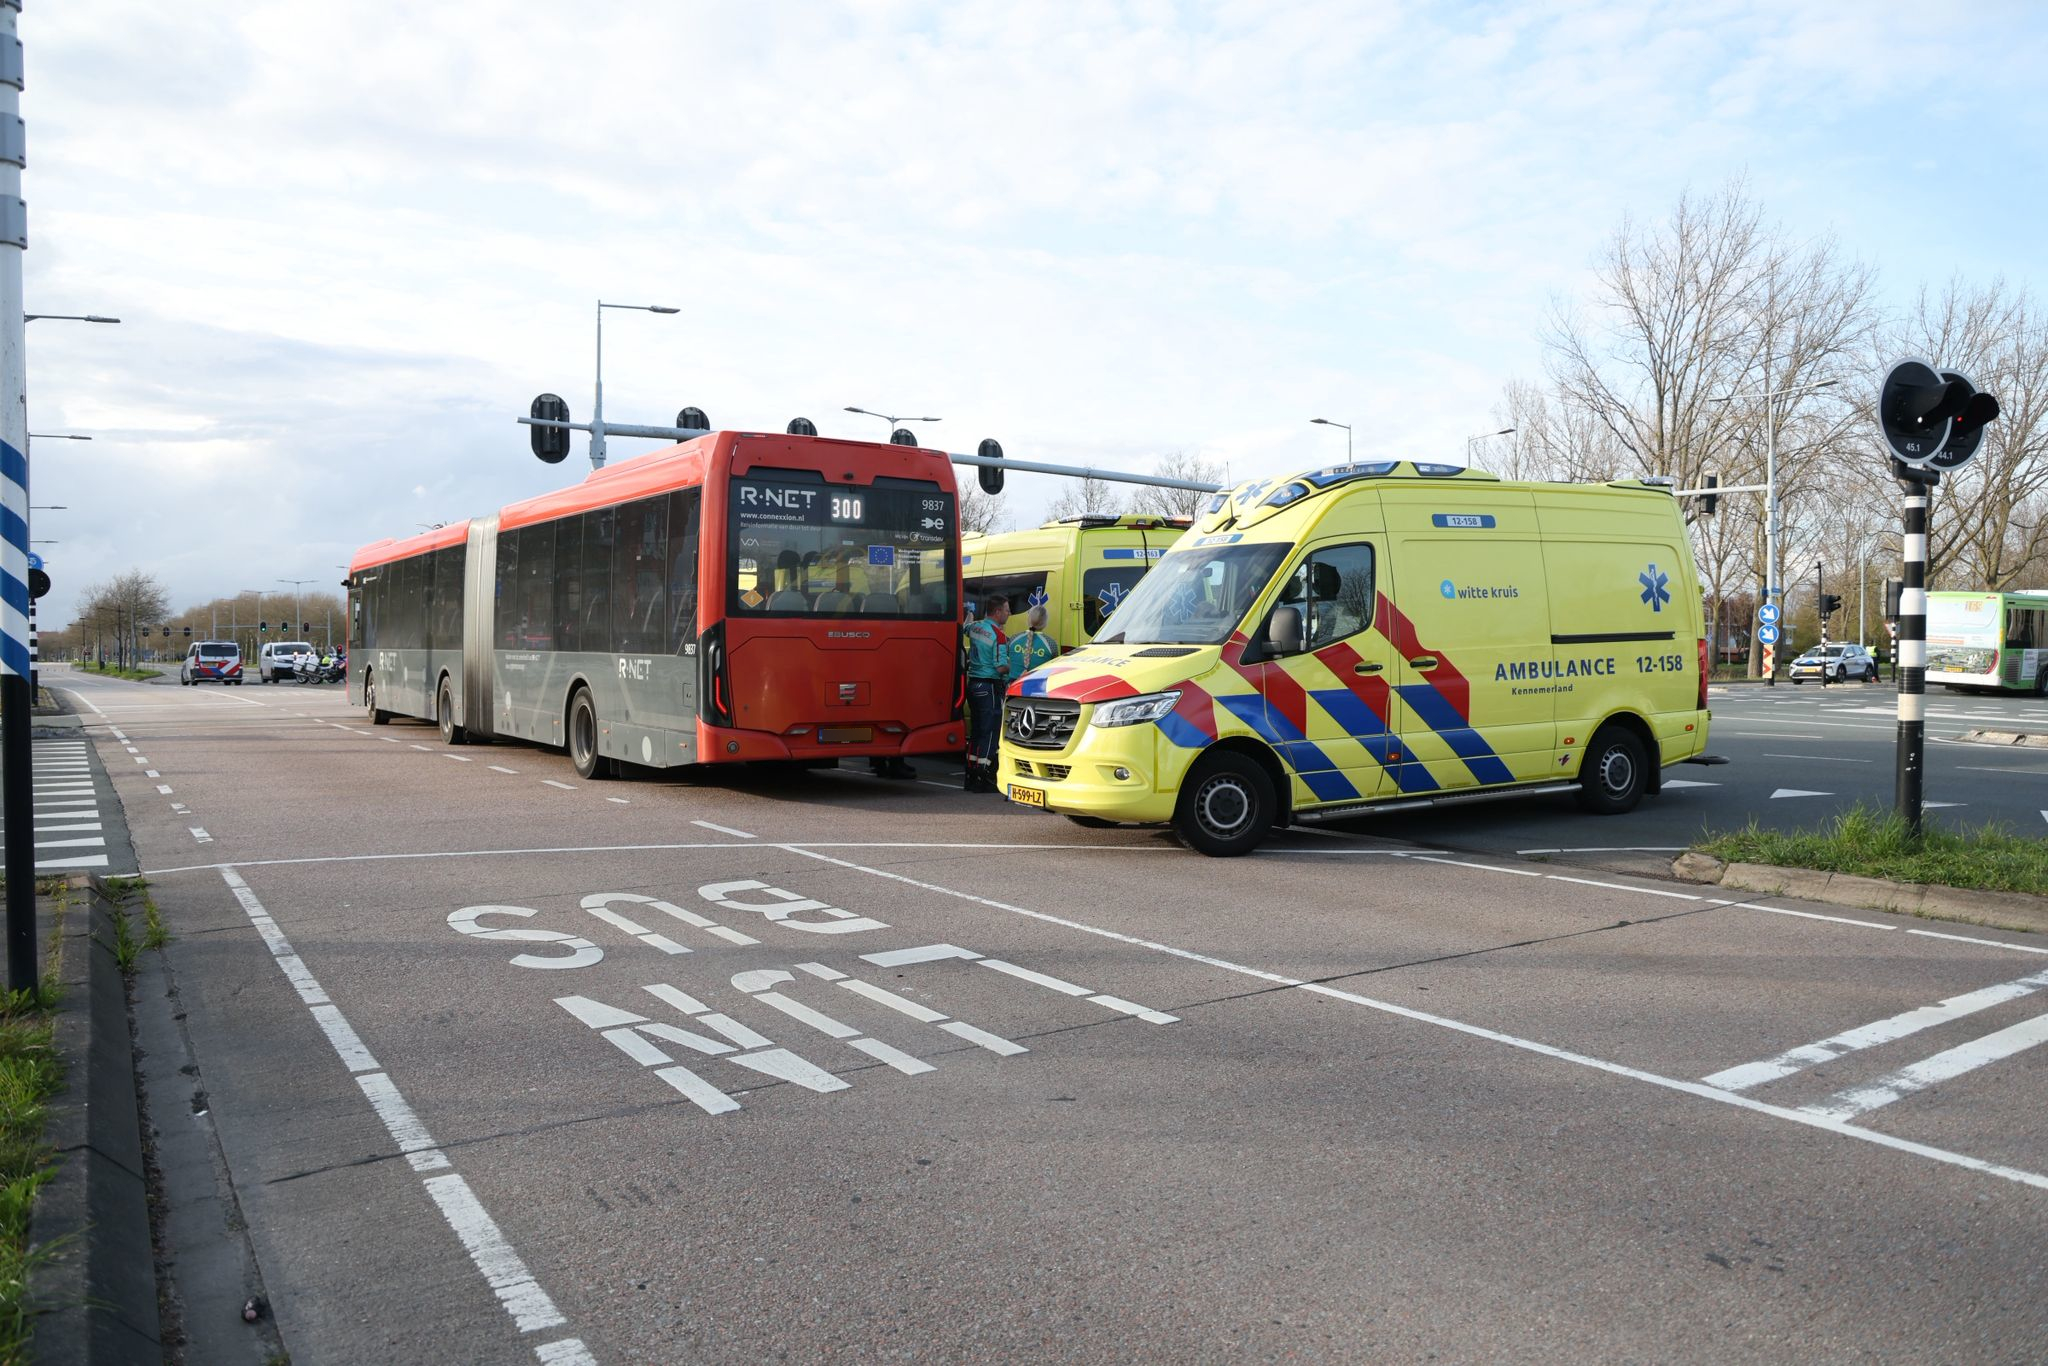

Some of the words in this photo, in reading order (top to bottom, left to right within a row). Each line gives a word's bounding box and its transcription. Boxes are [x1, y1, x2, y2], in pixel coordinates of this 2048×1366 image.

[1906, 443, 1920, 452] 45.1
[832, 498, 861, 519] 300
[922, 499, 944, 511] 9837
[740, 513, 805, 521] www.connexxion.nl
[1452, 517, 1477, 525] 12-158
[1136, 550, 1159, 558] 12-163
[1458, 586, 1488, 599] witte
[1491, 585, 1519, 598] kruis
[684, 643, 696, 655] 9837
[1495, 658, 1616, 681] AMBULANCE
[1636, 655, 1683, 673] 12-158
[1511, 684, 1573, 696] Kennemerland
[1012, 787, 1042, 804] H-599-LZ
[447, 880, 891, 969] BUS
